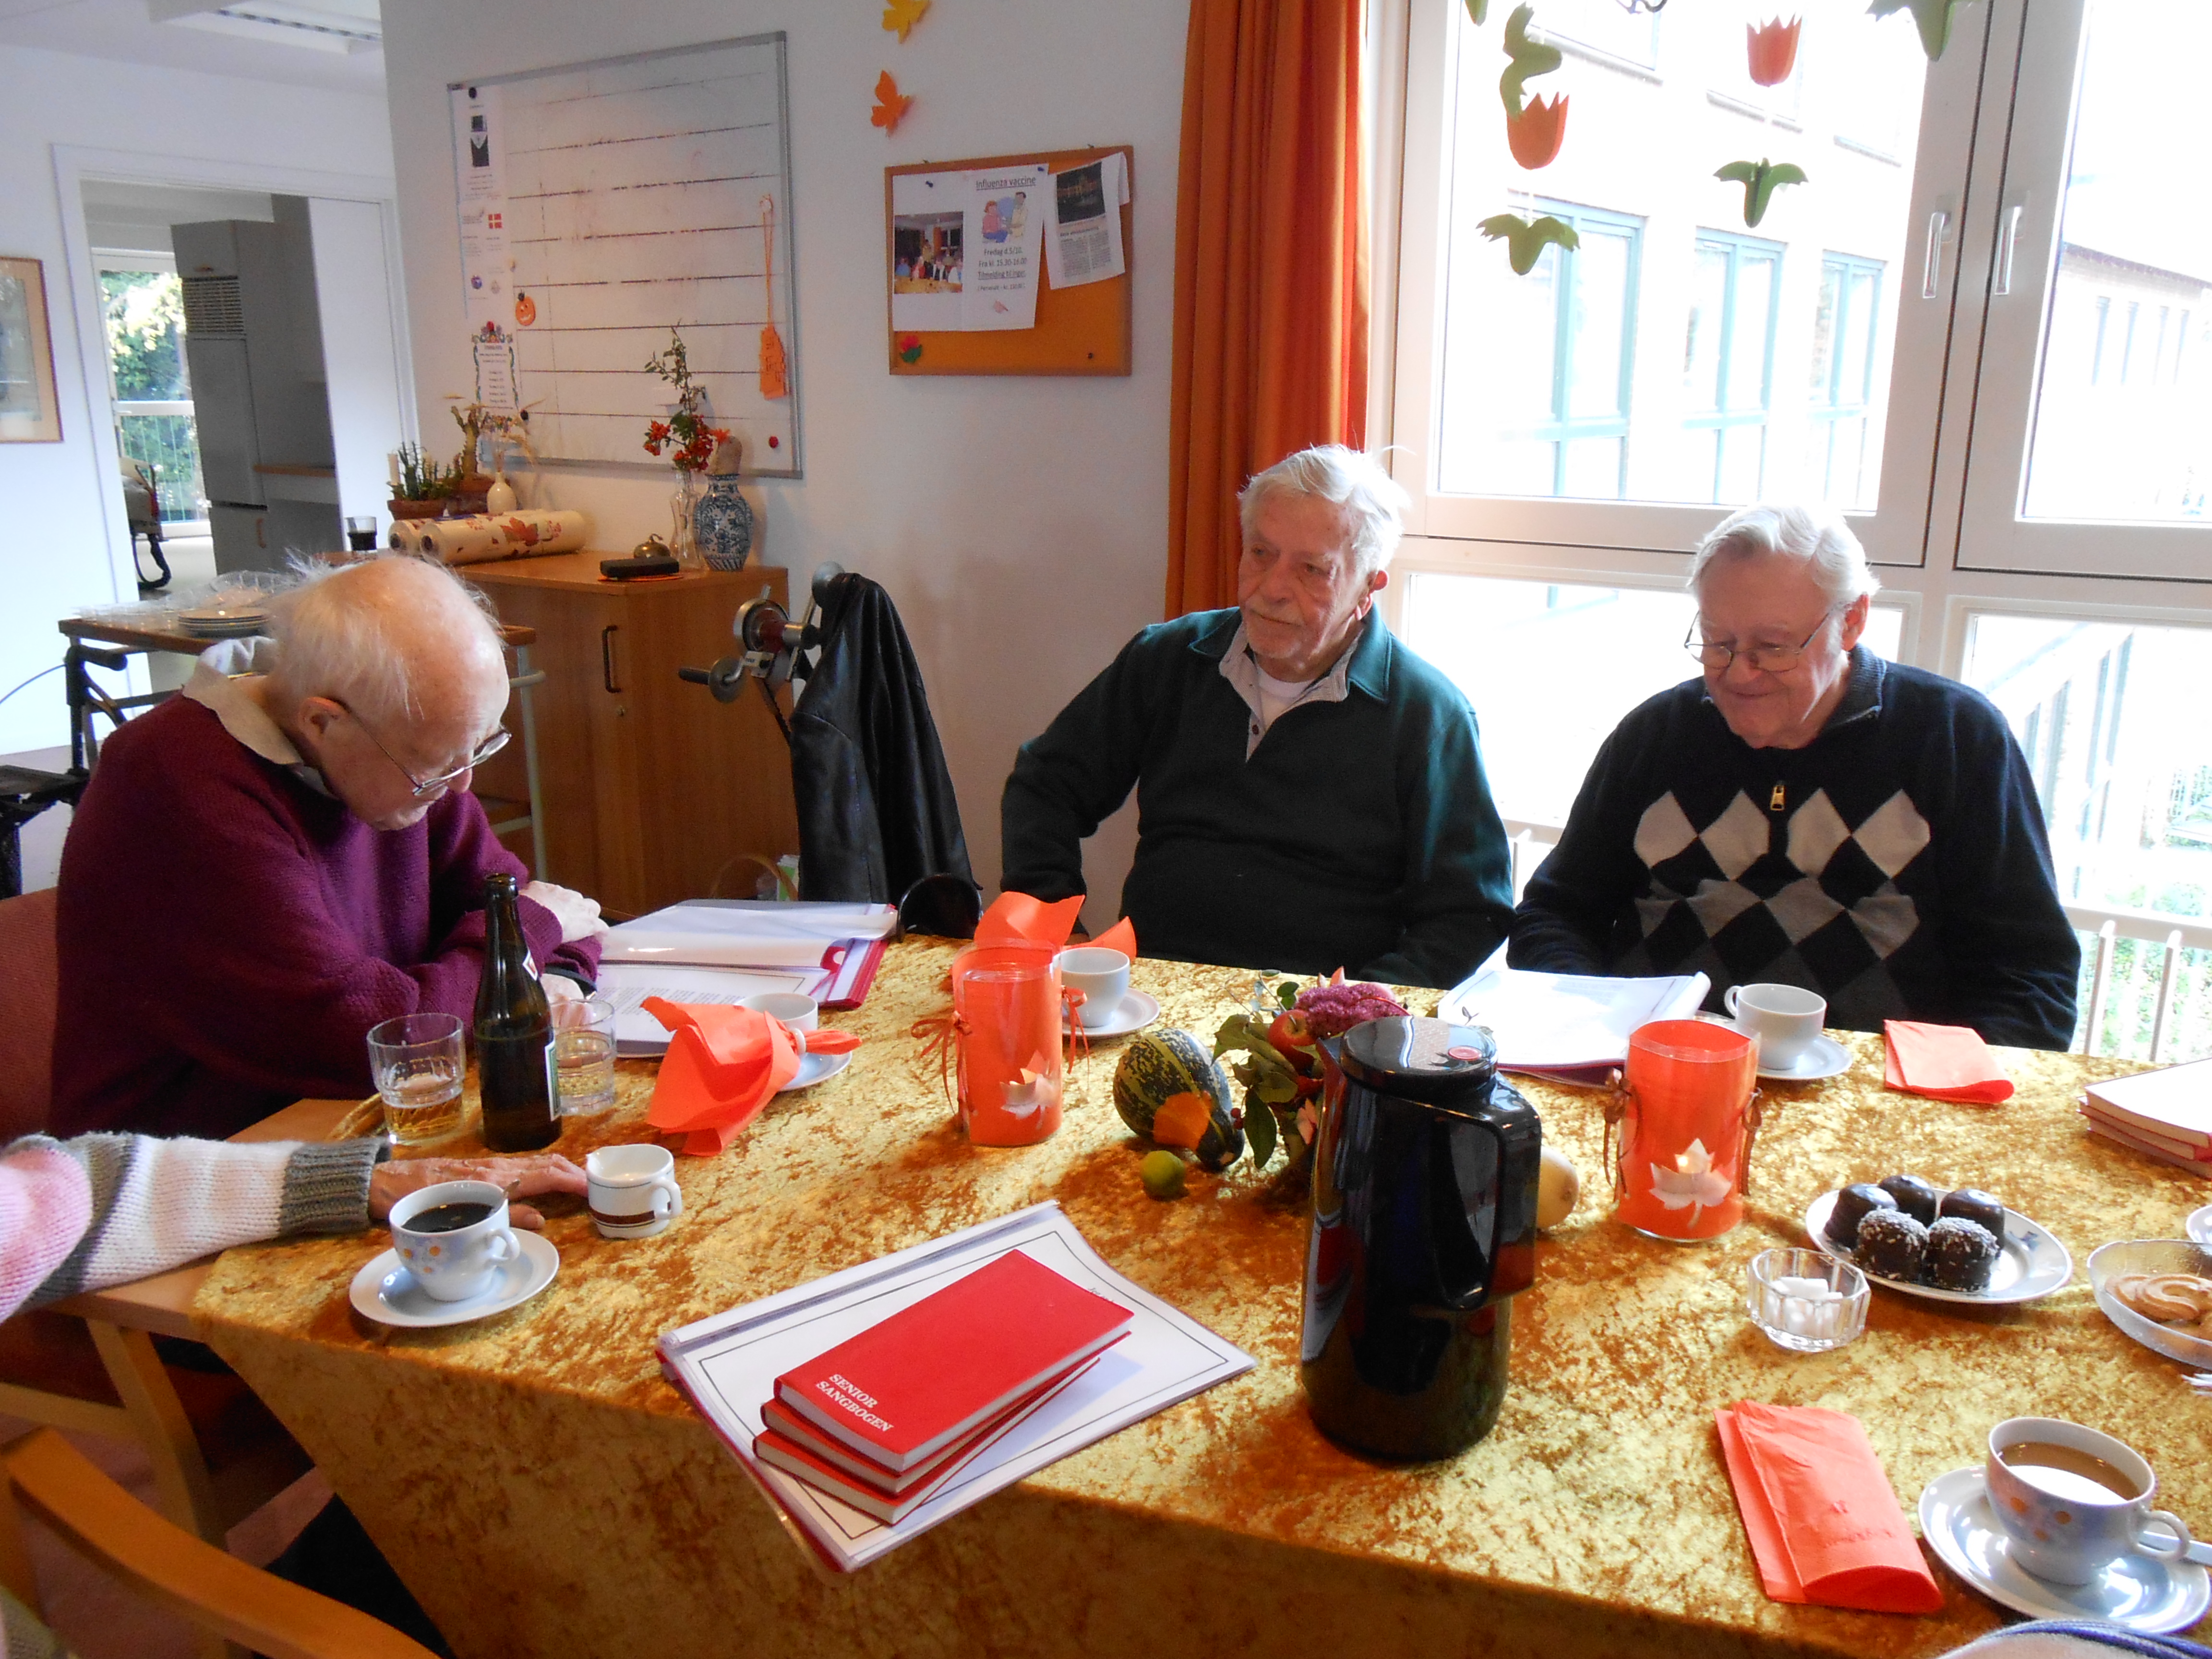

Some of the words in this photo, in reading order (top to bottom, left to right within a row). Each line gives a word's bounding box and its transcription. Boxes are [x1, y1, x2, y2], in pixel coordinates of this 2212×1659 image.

[976, 179, 1008, 188] Influenza
[1009, 176, 1036, 186] vaccine
[984, 248, 1003, 256] Fredag
[829, 1374, 878, 1408] SENIOR
[816, 1381, 894, 1432] SANGBOGEN
